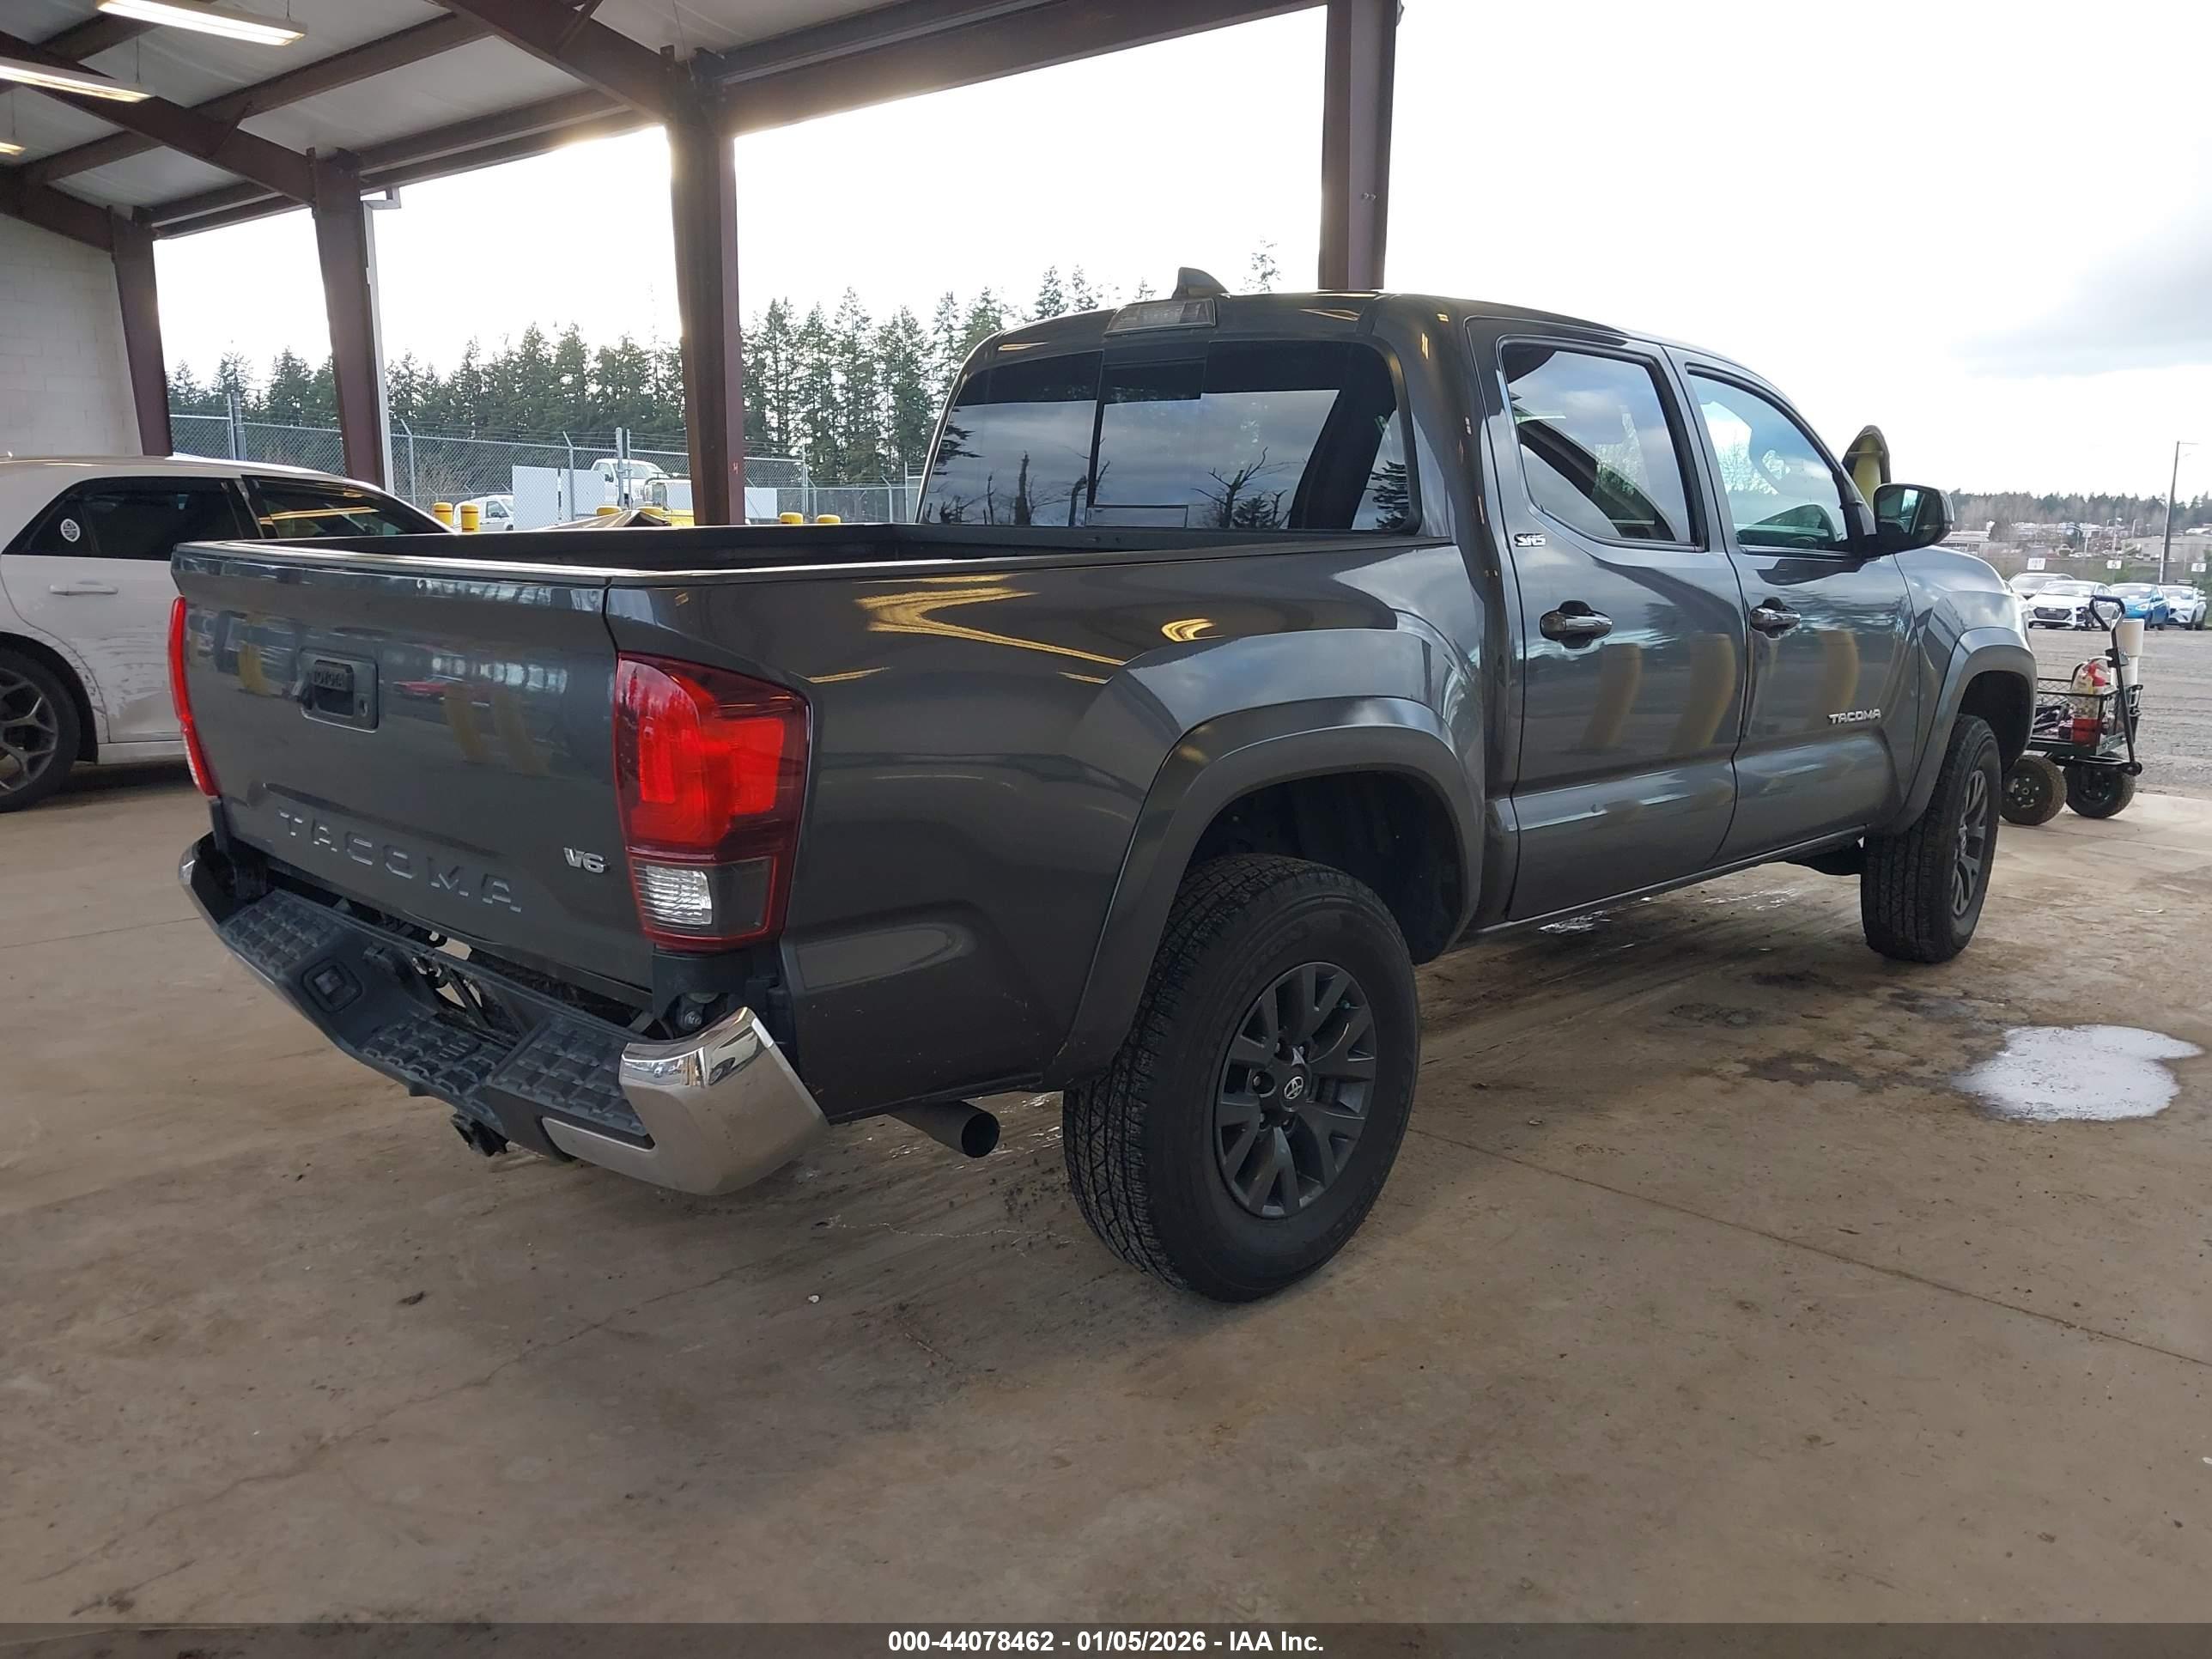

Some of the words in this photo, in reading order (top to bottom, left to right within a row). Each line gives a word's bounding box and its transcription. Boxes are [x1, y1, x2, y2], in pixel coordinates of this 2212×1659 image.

[1828, 708, 1881, 724] TACOMA
[278, 808, 522, 913] TACOMA
[563, 847, 606, 873] V6
